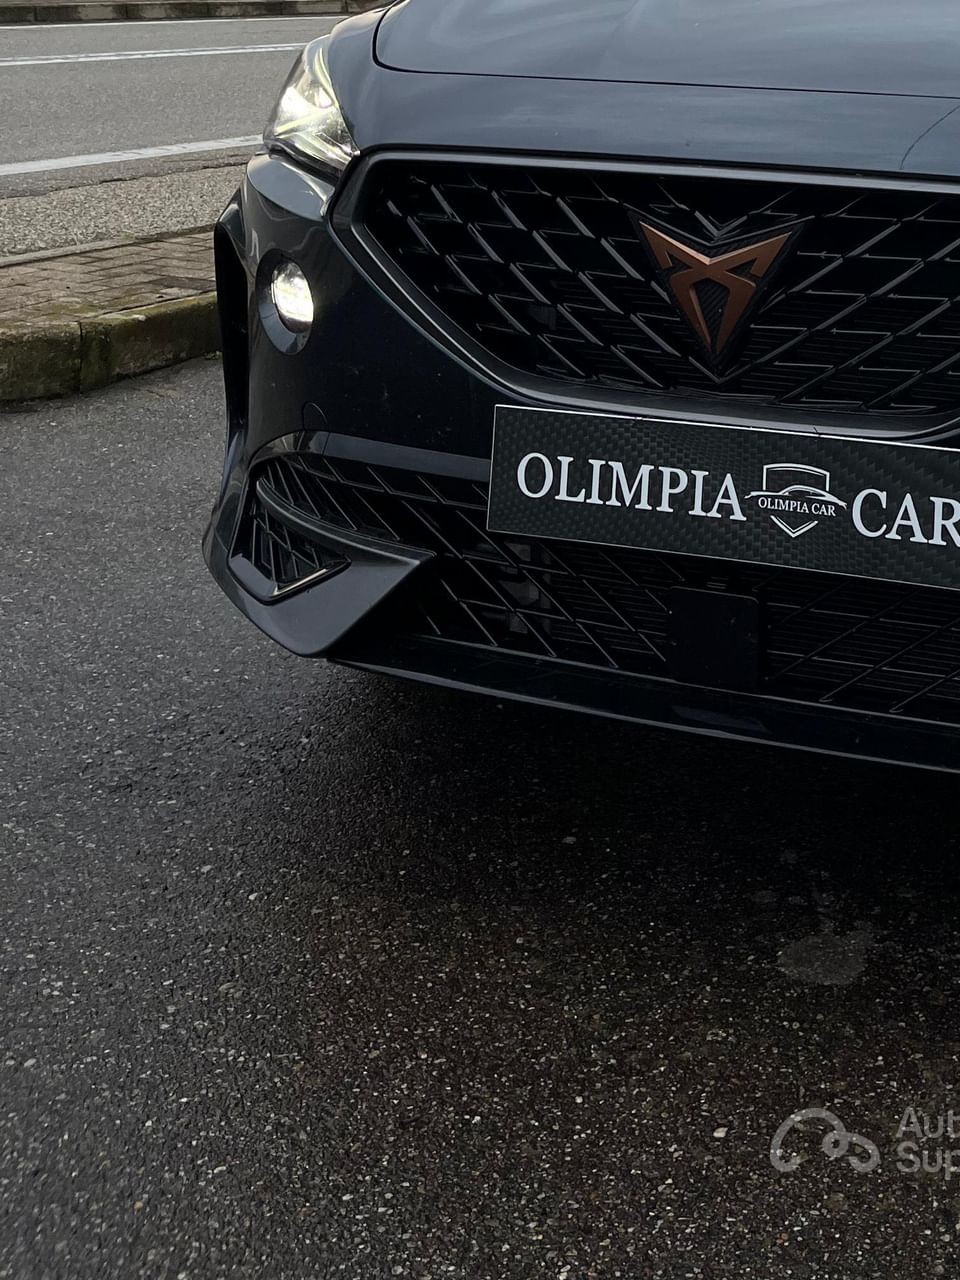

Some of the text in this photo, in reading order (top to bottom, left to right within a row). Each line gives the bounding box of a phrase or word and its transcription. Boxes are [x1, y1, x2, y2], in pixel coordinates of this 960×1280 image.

[517, 452, 747, 521] OLIMPIA
[758, 496, 837, 517] OLIMPIA CAR
